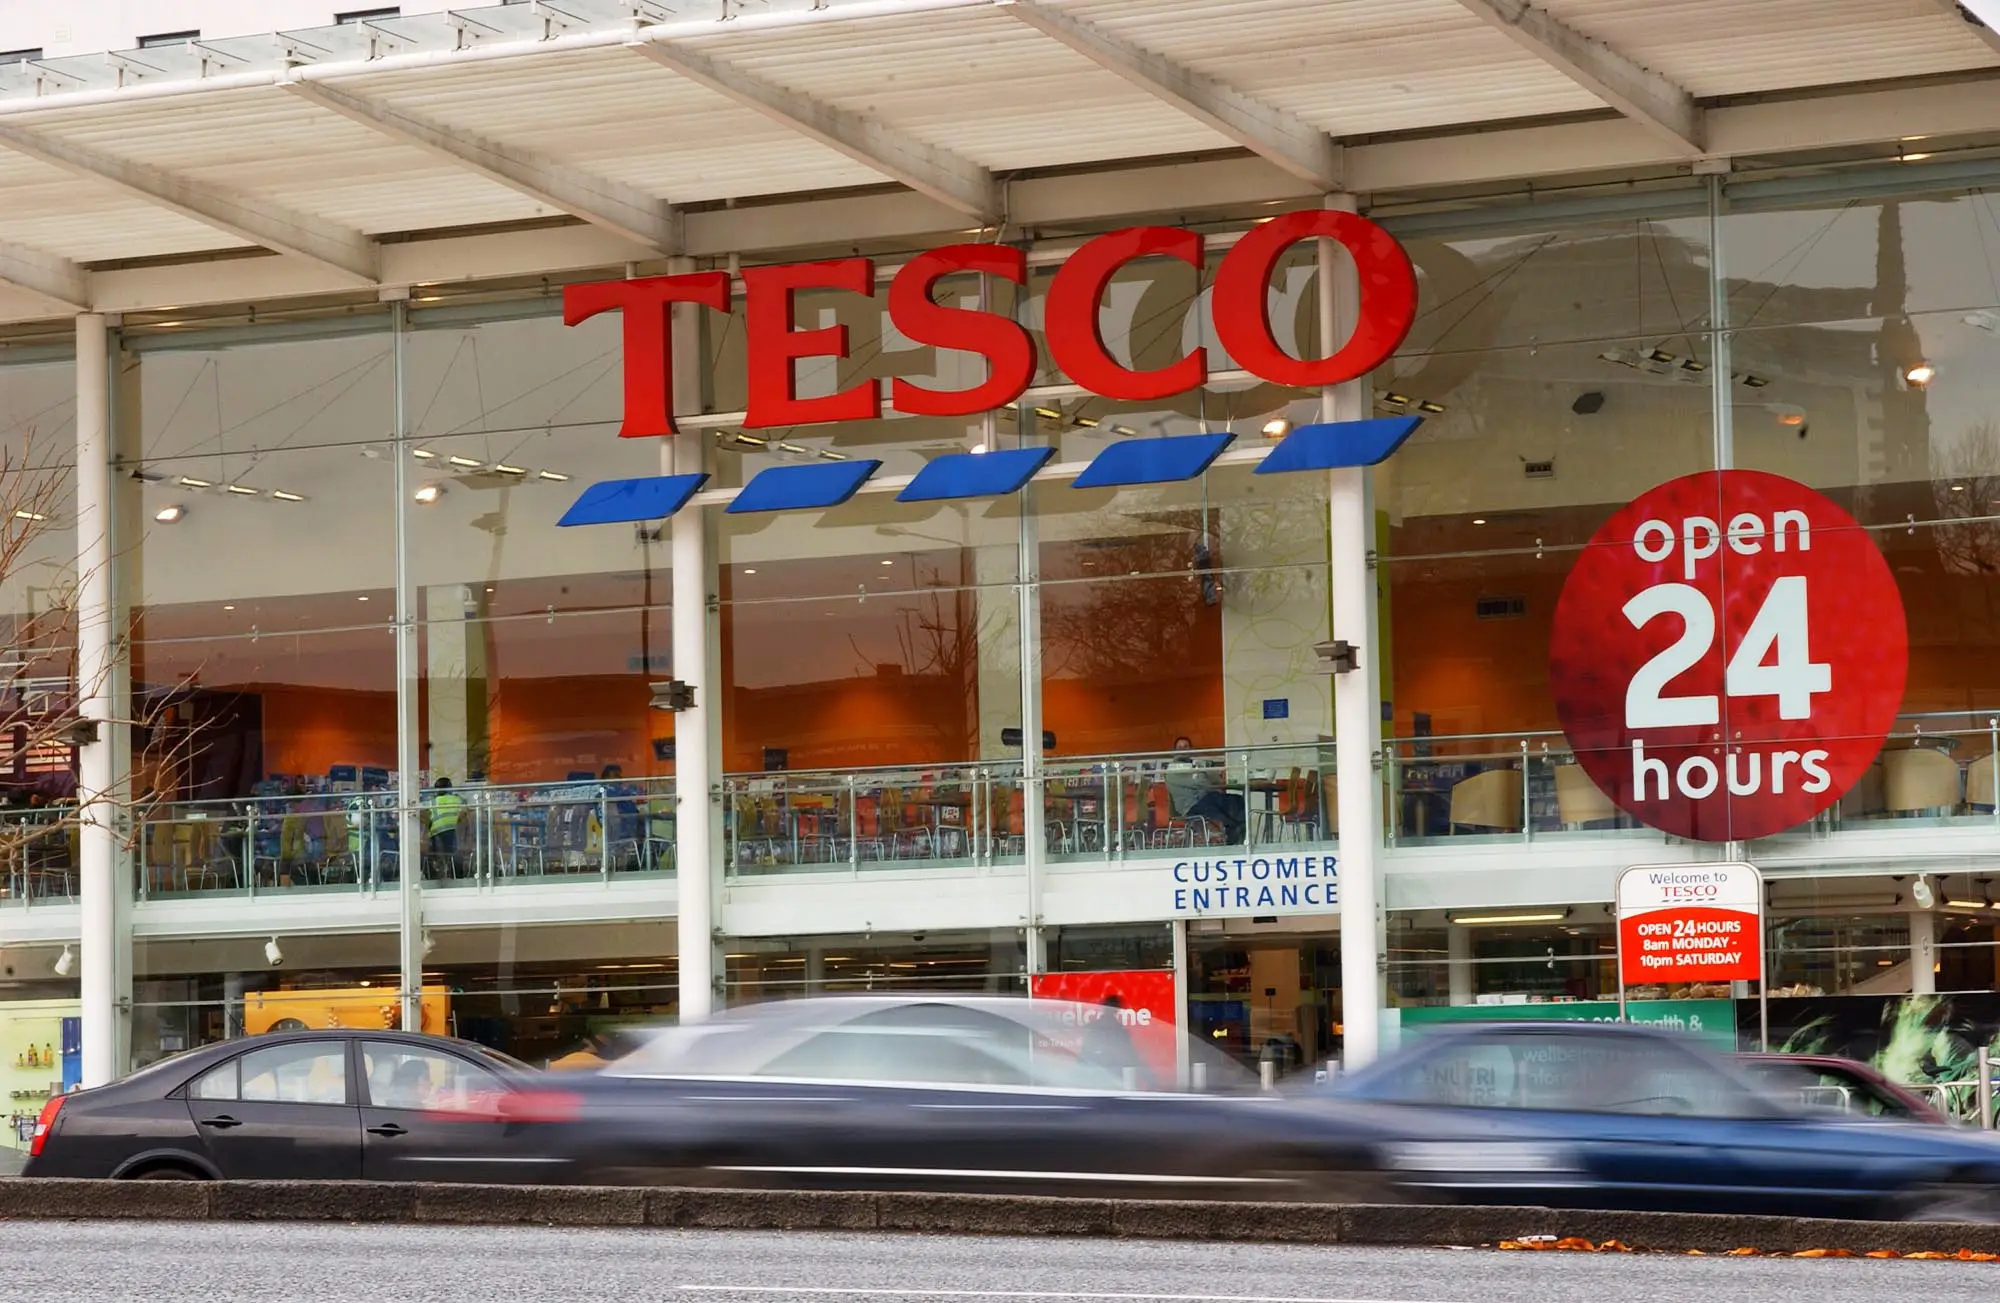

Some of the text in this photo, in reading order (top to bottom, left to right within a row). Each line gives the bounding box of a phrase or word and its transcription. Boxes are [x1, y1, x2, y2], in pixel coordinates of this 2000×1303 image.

[563, 209, 1419, 438] TESCO
[1633, 509, 1811, 580] open
[1622, 576, 1831, 729] 24
[1632, 739, 1831, 801] hours
[1173, 856, 1338, 883] CUSTOMER
[1649, 872, 1728, 884] Welcome to
[1174, 883, 1338, 909] ENTRANCE
[1661, 885, 1718, 897] TESCO
[1638, 920, 1741, 937] OPEN 24 HOURS
[1643, 939, 1669, 951] 8am
[1672, 937, 1729, 950] MONDAY
[1640, 952, 1742, 968] 10pm SATURDAY
